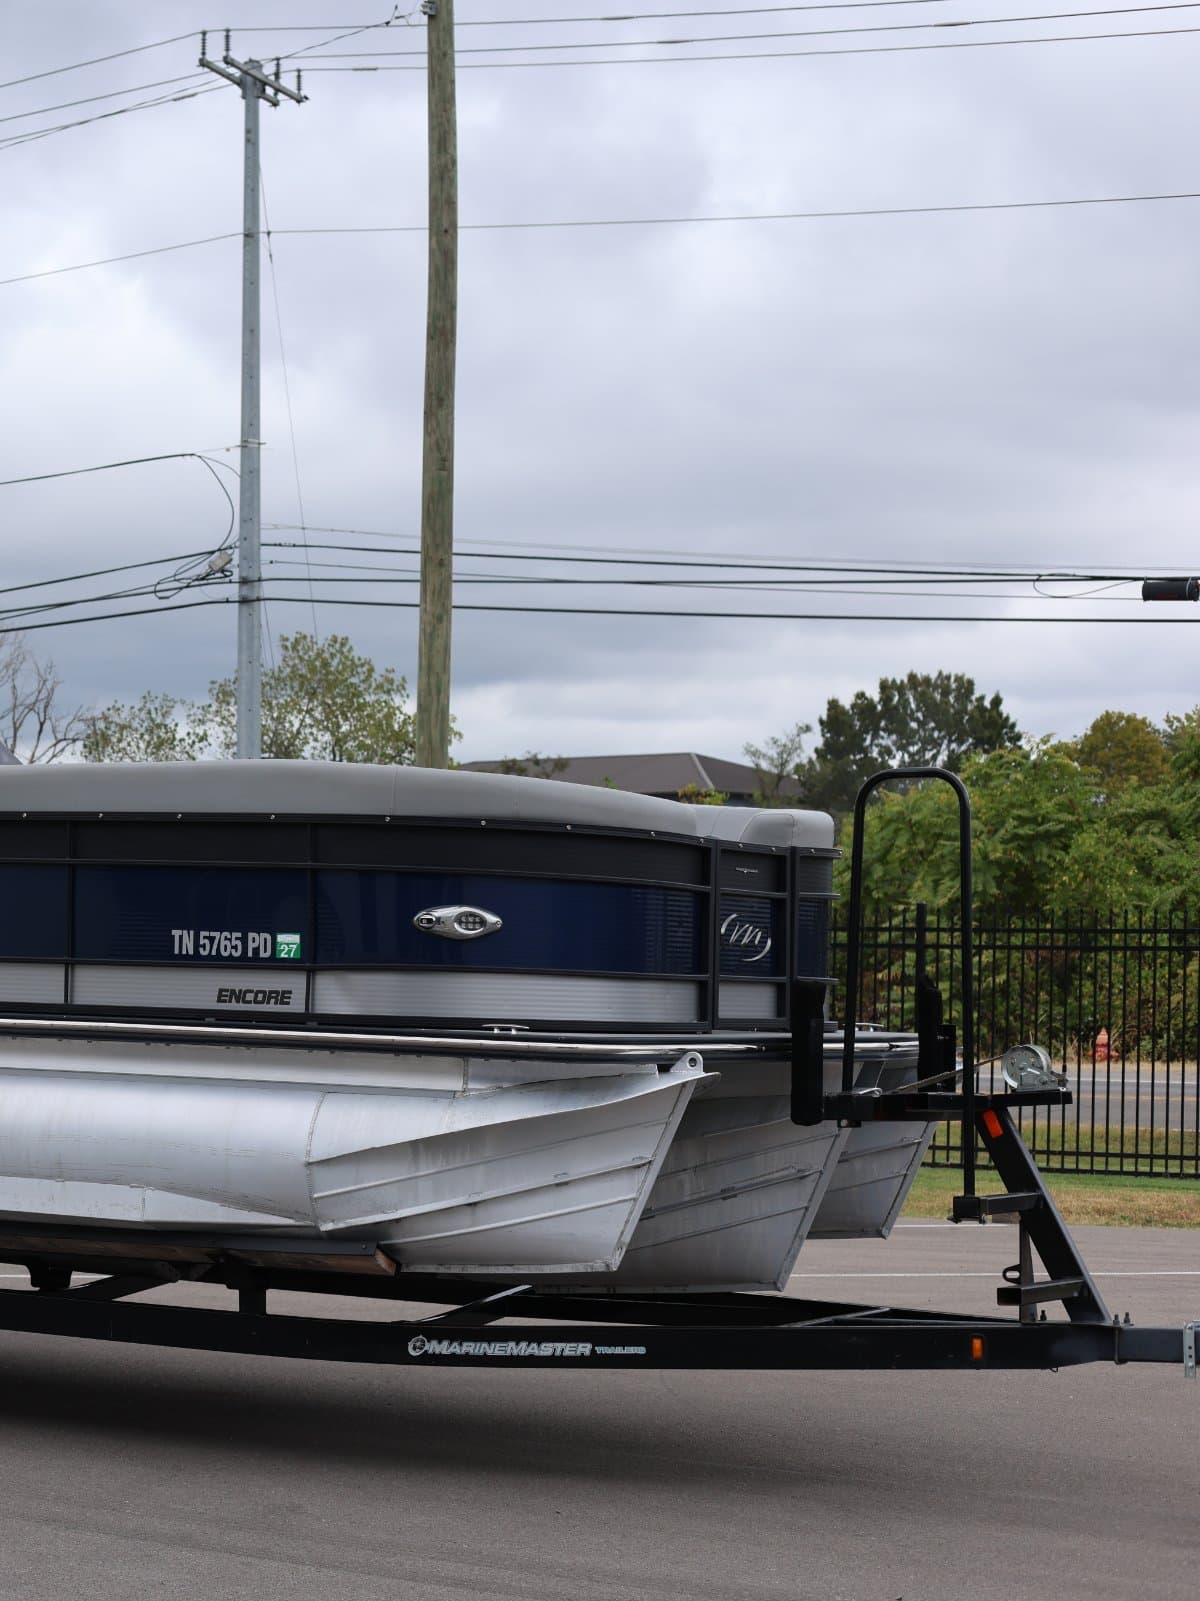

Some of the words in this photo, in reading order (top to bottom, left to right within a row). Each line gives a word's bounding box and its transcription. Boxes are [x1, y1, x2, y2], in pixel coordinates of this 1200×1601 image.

[171, 929, 195, 955] TN
[199, 930, 242, 957] 5765
[247, 932, 272, 958] PD
[280, 943, 298, 958] 27
[216, 987, 293, 1006] ENCORE
